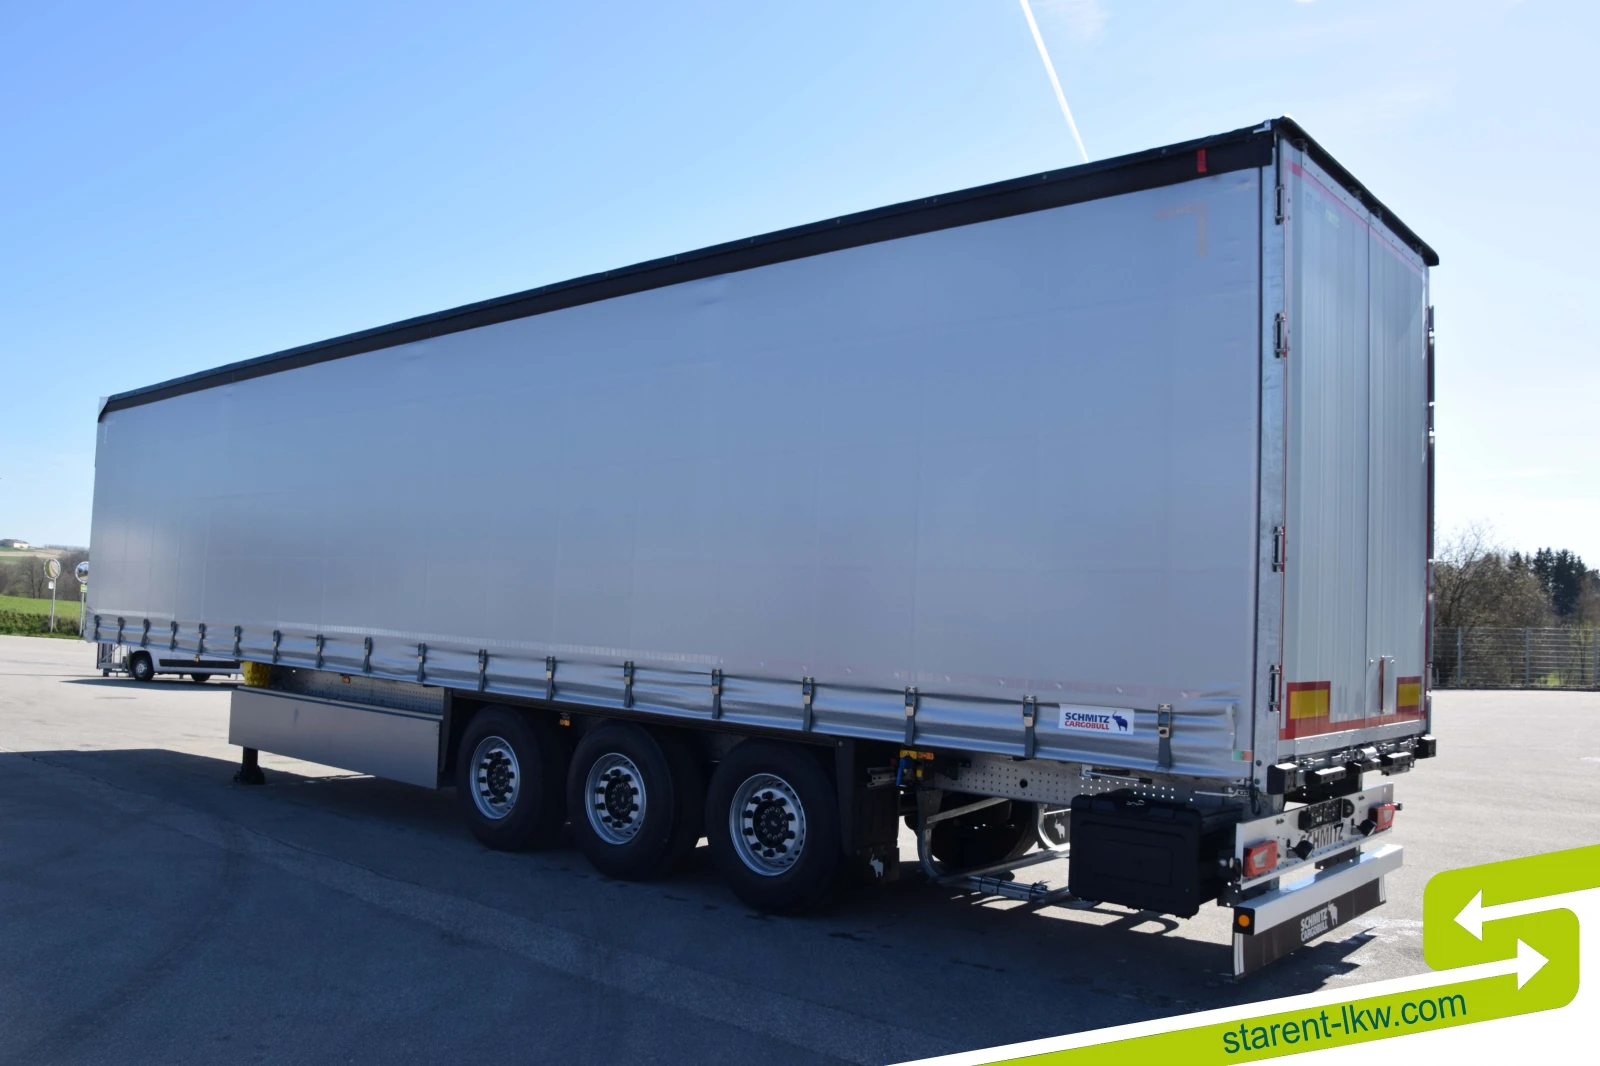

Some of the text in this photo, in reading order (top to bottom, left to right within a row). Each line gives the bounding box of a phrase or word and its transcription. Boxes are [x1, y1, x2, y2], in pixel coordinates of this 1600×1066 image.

[1065, 712, 1110, 724] SCHMITZ
[1064, 720, 1110, 730] CARGOBULL
[1301, 907, 1328, 932] SCHMITZ
